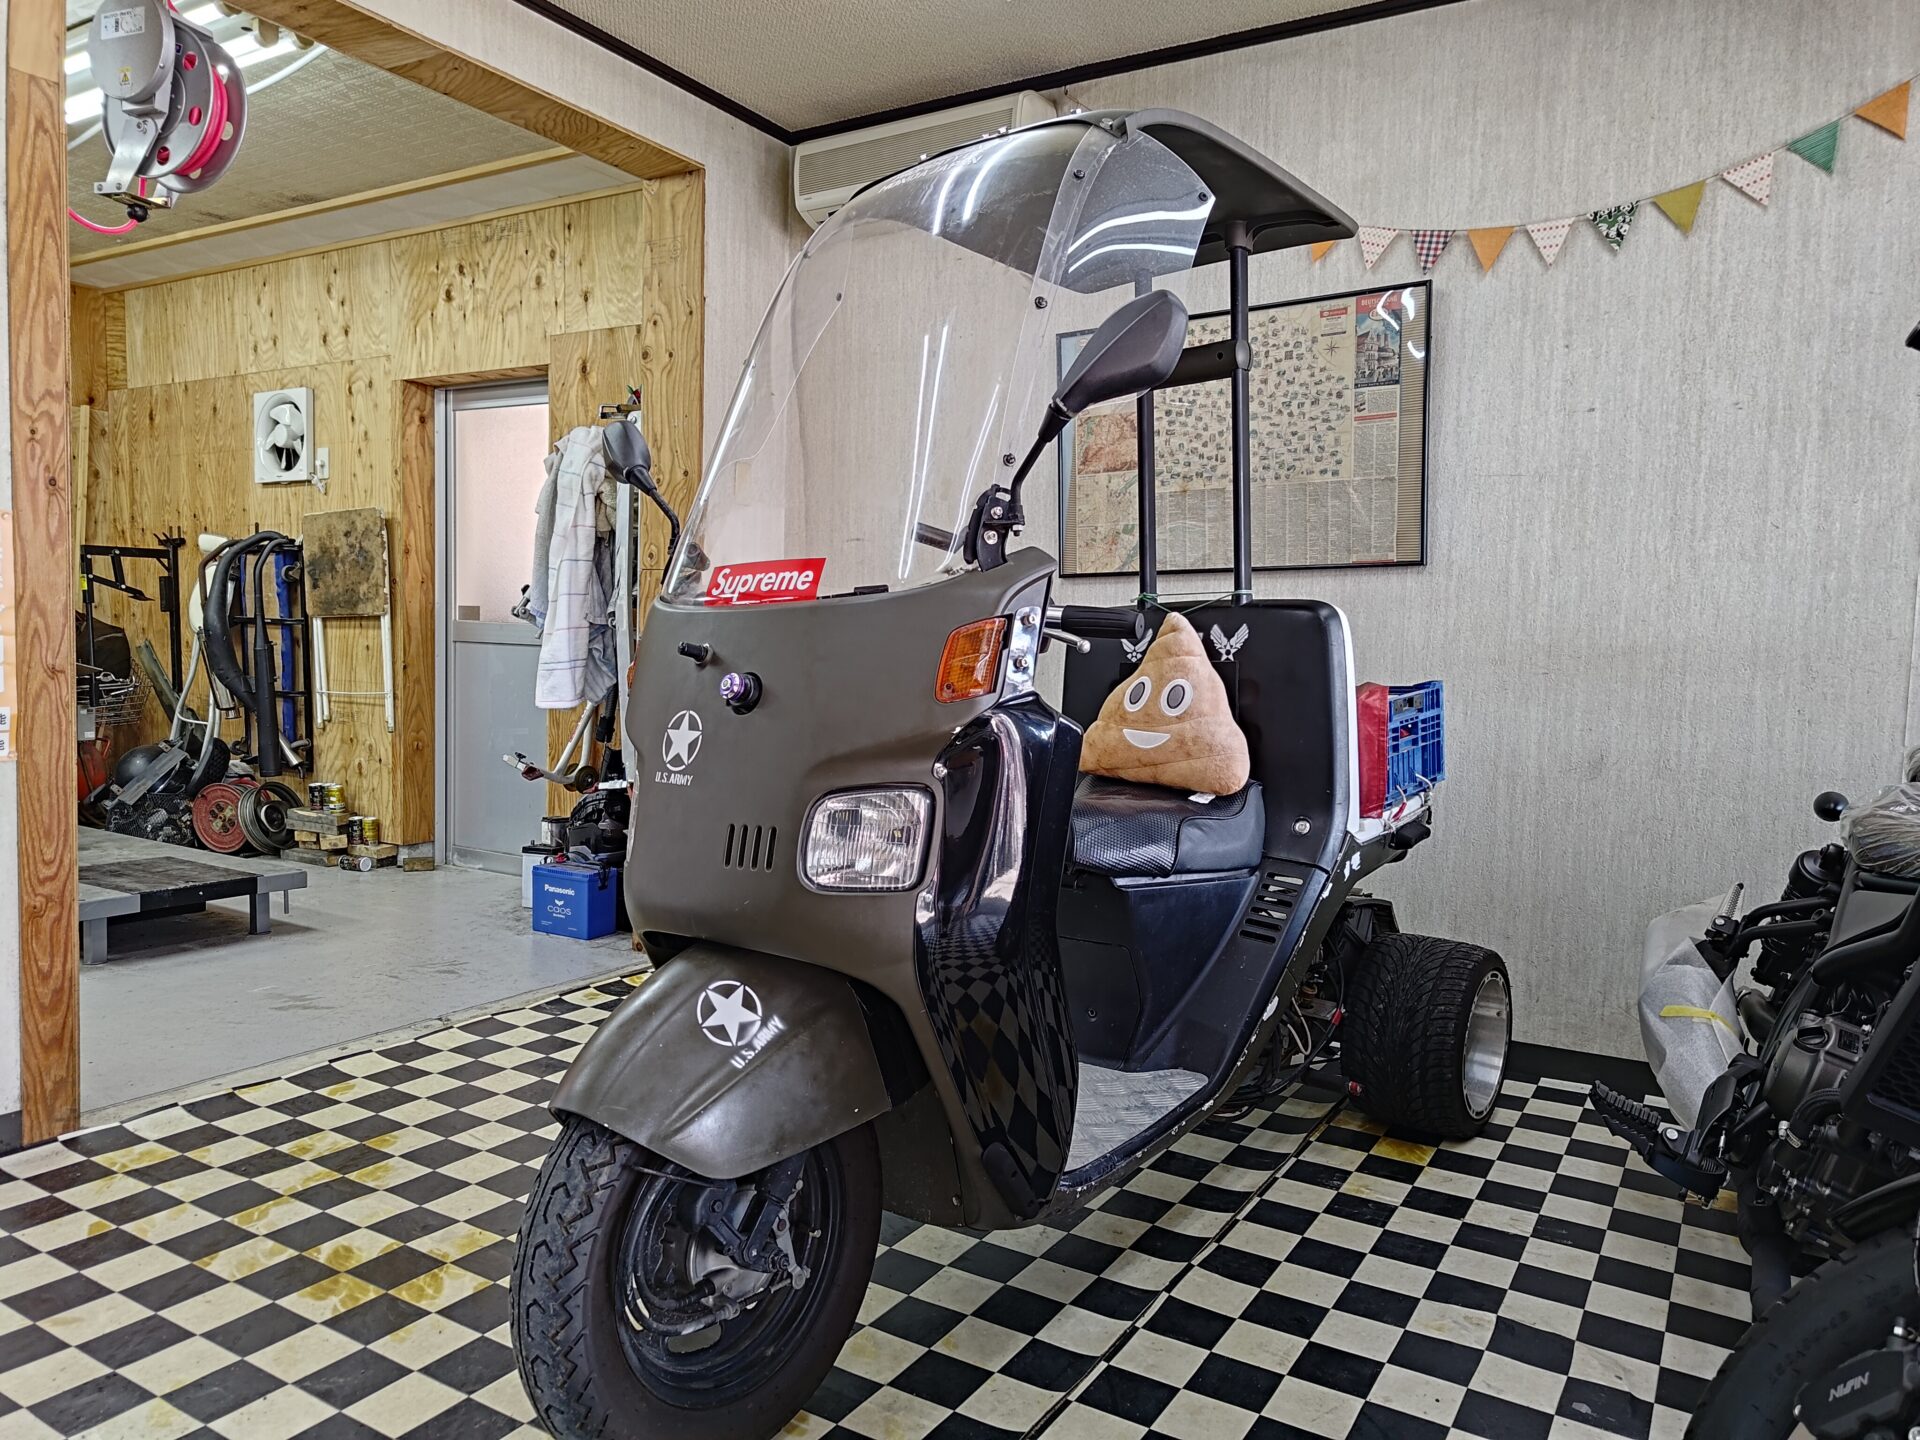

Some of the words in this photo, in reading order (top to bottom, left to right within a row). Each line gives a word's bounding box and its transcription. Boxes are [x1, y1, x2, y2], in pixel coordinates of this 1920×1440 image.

[711, 568, 814, 601] Supreme
[544, 884, 575, 896] Panasonic
[547, 904, 572, 916] caos
